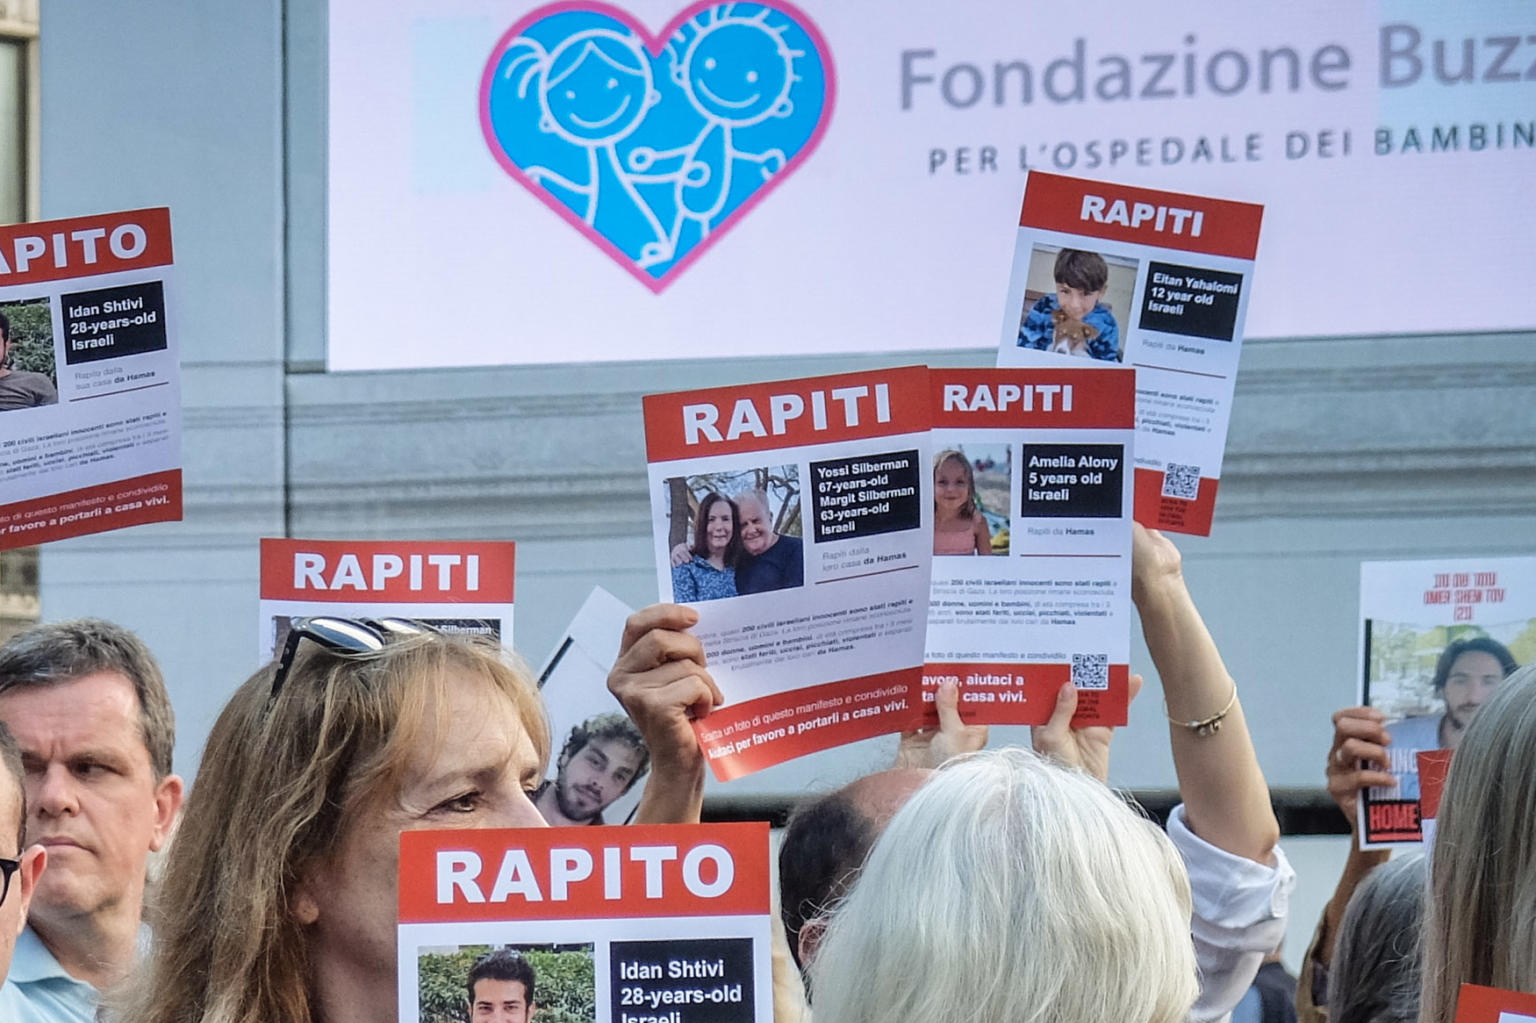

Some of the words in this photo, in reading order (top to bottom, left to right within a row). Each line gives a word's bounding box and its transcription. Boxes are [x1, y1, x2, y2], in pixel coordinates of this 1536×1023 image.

[900, 33, 1352, 111] Fondazione
[929, 146, 997, 175] PER
[1019, 132, 1264, 171] L'OSPEDALE
[1285, 129, 1350, 160] DEI
[1080, 194, 1204, 237] RAPITI
[1152, 272, 1183, 286] Eitan
[1151, 286, 1165, 298] 12
[1165, 290, 1193, 302] year
[1193, 293, 1214, 305] old
[69, 305, 100, 318] Idan
[102, 296, 143, 313] Shtivi
[1147, 299, 1184, 315] Israeli
[70, 310, 156, 335] 28-years-old
[71, 333, 114, 351] Israeli
[943, 384, 1072, 411] RAPITI
[682, 383, 890, 445] RAPITI
[817, 464, 849, 479] Yossi
[851, 459, 909, 474] Silberman
[1028, 455, 1075, 468] Amelia
[1077, 455, 1118, 471] Alony
[818, 474, 888, 493] 67-years-old
[1028, 472, 1037, 484] 5
[1039, 474, 1077, 487] years
[1080, 472, 1102, 484] old
[819, 492, 856, 507] Margit
[858, 486, 915, 502] Silberman
[1028, 488, 1069, 501] Israeli
[820, 501, 889, 521] 63-years-old
[821, 520, 855, 535] Israeli
[294, 552, 479, 591] RAPITI
[1369, 804, 1419, 830] HOME
[436, 843, 734, 904] RAPITO
[620, 961, 662, 979] Idan
[668, 959, 724, 978] Shtivi
[621, 984, 742, 1009] 28-years-old
